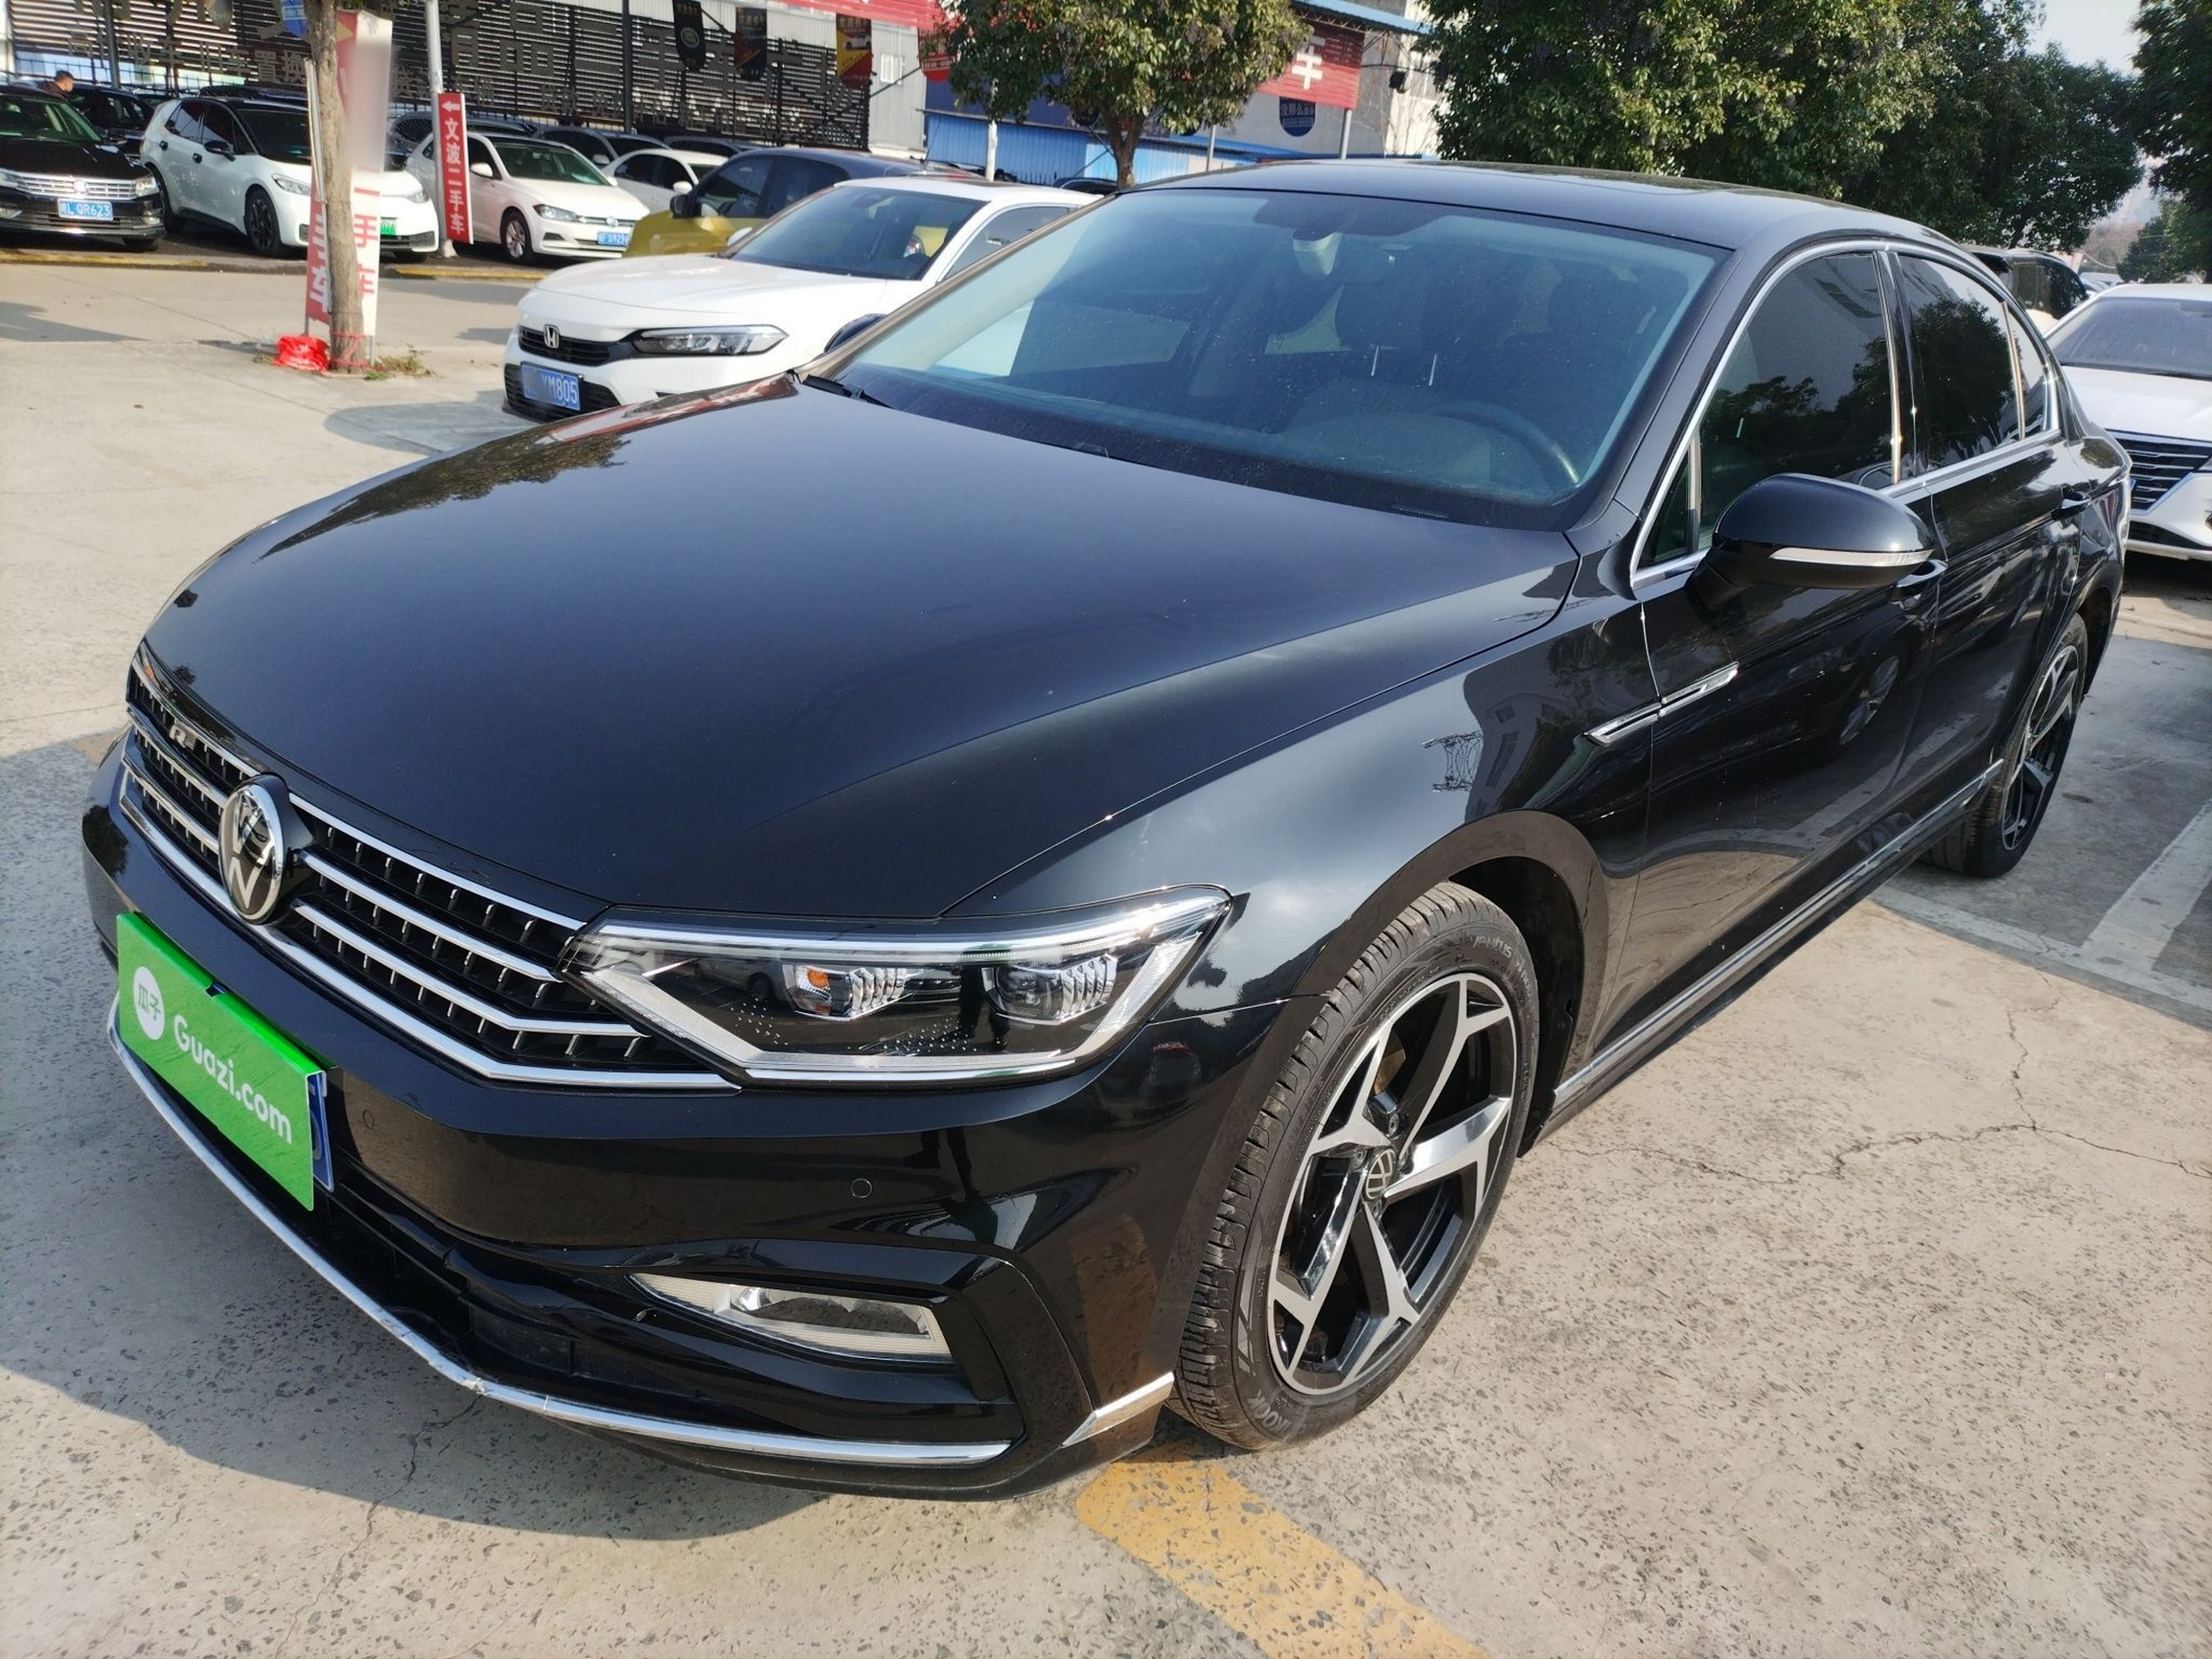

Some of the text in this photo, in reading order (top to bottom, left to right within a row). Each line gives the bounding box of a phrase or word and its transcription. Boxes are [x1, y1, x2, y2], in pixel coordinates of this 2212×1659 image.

[445, 117, 465, 235] 文波二手车
[138, 983, 293, 1145] 瓜子 Guazi.com
